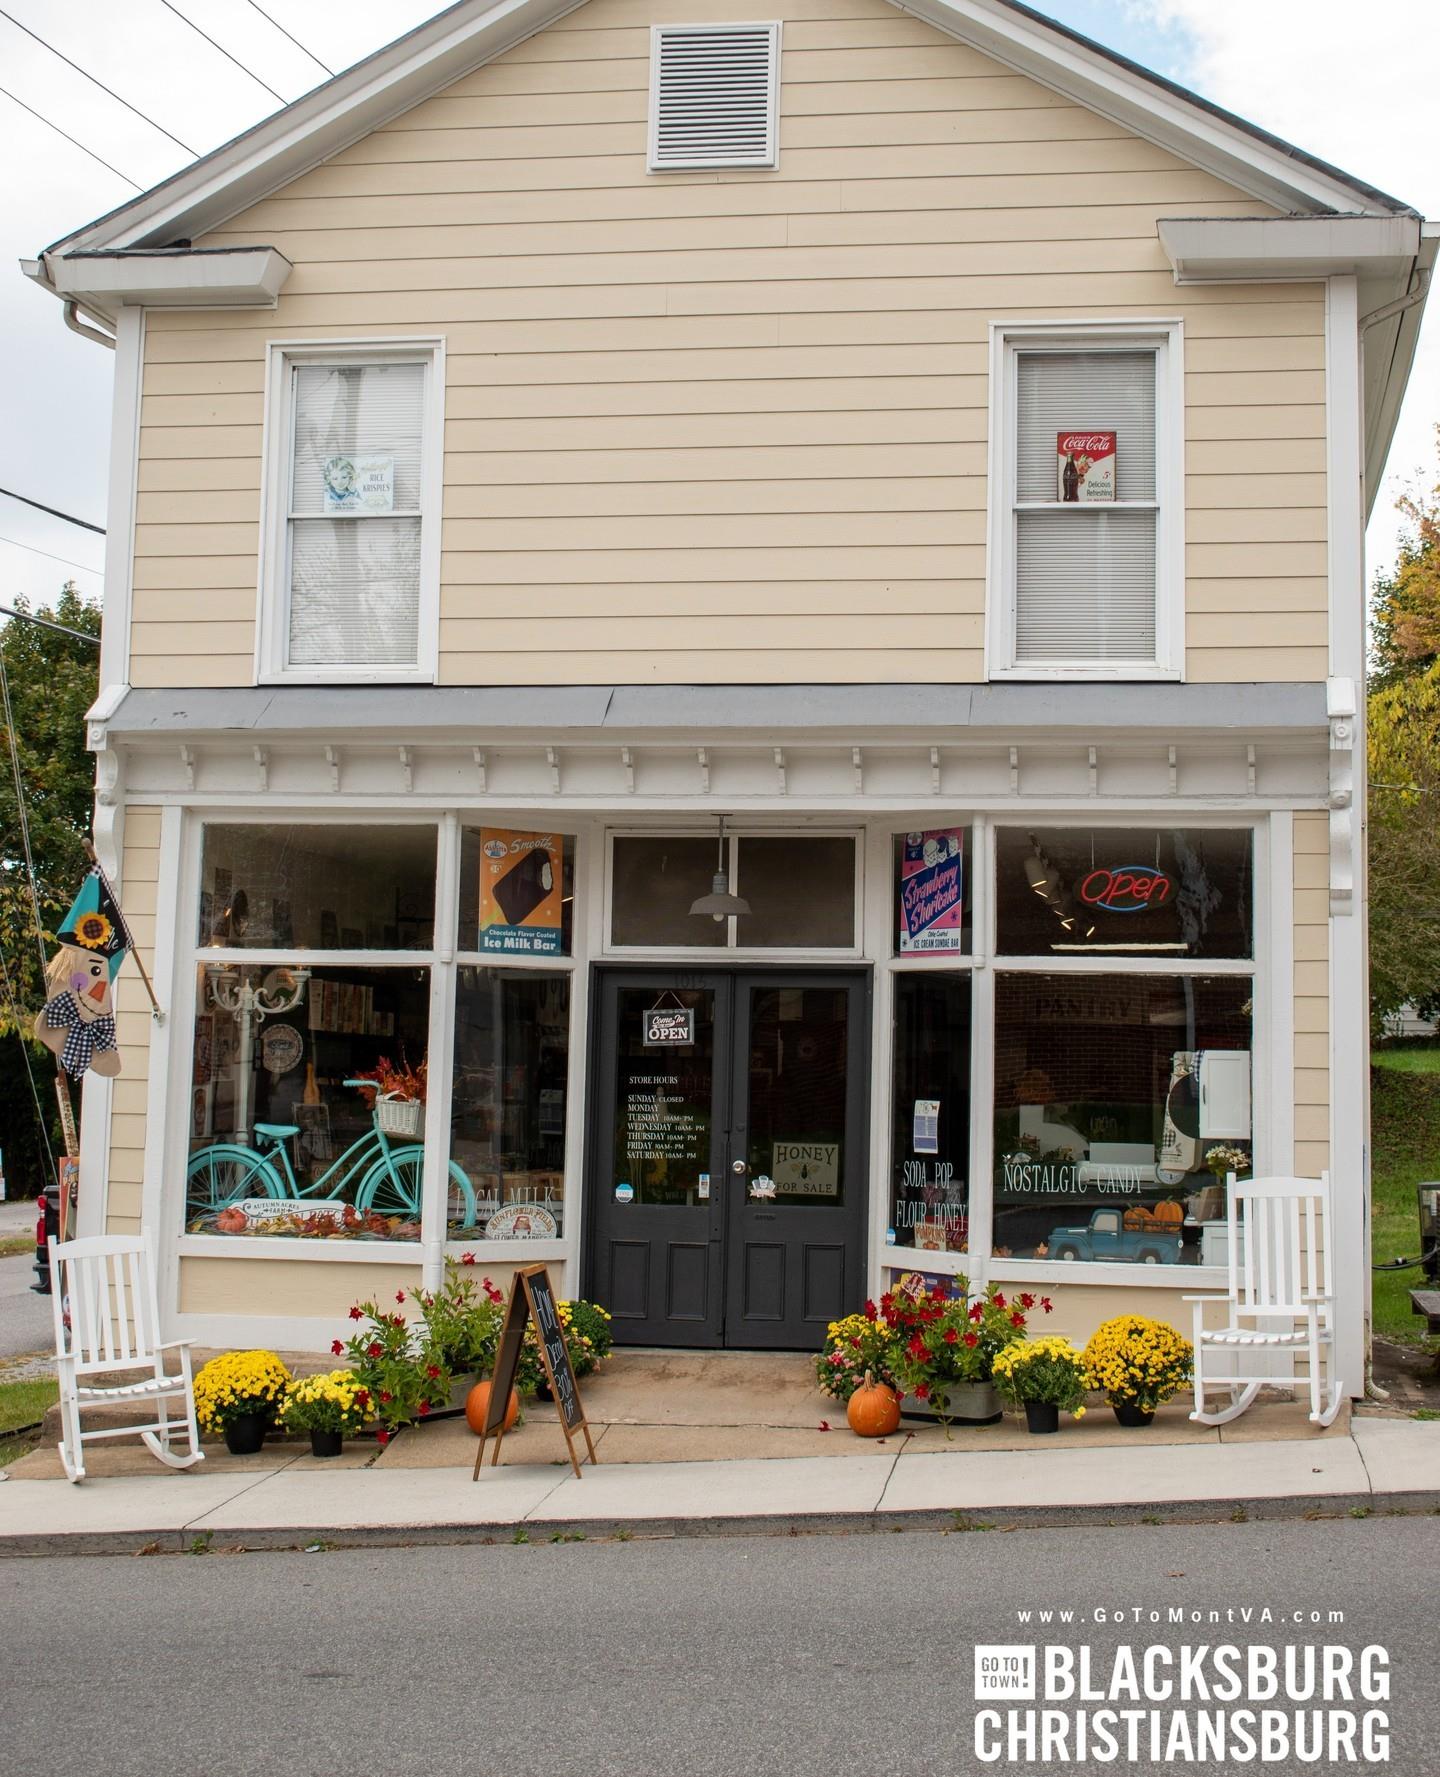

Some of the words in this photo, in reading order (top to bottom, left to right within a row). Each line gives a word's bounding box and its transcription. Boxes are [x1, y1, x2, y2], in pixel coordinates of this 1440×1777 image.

[1063, 435, 1112, 450] Coca-Cola
[362, 484, 390, 492] KRISPIES
[1088, 480, 1111, 488] Delicious
[510, 835, 556, 854] Smooth
[905, 865, 958, 910] Strawberry
[1081, 870, 1169, 905] Open
[911, 884, 958, 932] Shortcake
[489, 929, 516, 937] Chocolate
[536, 931, 556, 939] Coated
[484, 936, 501, 948] Ice
[503, 937, 531, 949] Milk
[533, 939, 556, 950] Bar
[921, 939, 933, 948] CREAM
[934, 938, 949, 948] SUNDAE
[951, 938, 959, 948] BAR
[652, 1015, 675, 1027] Come
[674, 1014, 685, 1023] In
[648, 1027, 688, 1040] OPEN
[629, 1076, 653, 1085] STORE
[653, 1076, 678, 1084] HOURS
[628, 1095, 656, 1103] SUNDAY
[628, 1104, 658, 1112] MONDAY
[627, 1113, 659, 1121] TUESDAY
[627, 1123, 672, 1131] WEDNESDAY
[627, 1132, 665, 1140] THURSDAY
[627, 1141, 653, 1149] FRIDAY
[627, 1151, 665, 1159] SATURDAY
[775, 1145, 836, 1165] HONEY
[903, 1161, 927, 1187] SODA
[935, 1162, 953, 1189] POP
[1003, 1164, 1088, 1193] NOSTALGIC
[1097, 1165, 1142, 1193] CANDY
[776, 1183, 798, 1192] FOR
[803, 1183, 832, 1193] SALE
[253, 1202, 280, 1210] AUTUMN
[280, 1202, 299, 1210] ACRES
[456, 1187, 501, 1216] LCAL
[490, 1207, 533, 1231] SUNFLOWER
[896, 1200, 927, 1229] FLOUR
[934, 1203, 966, 1232] HONEY
